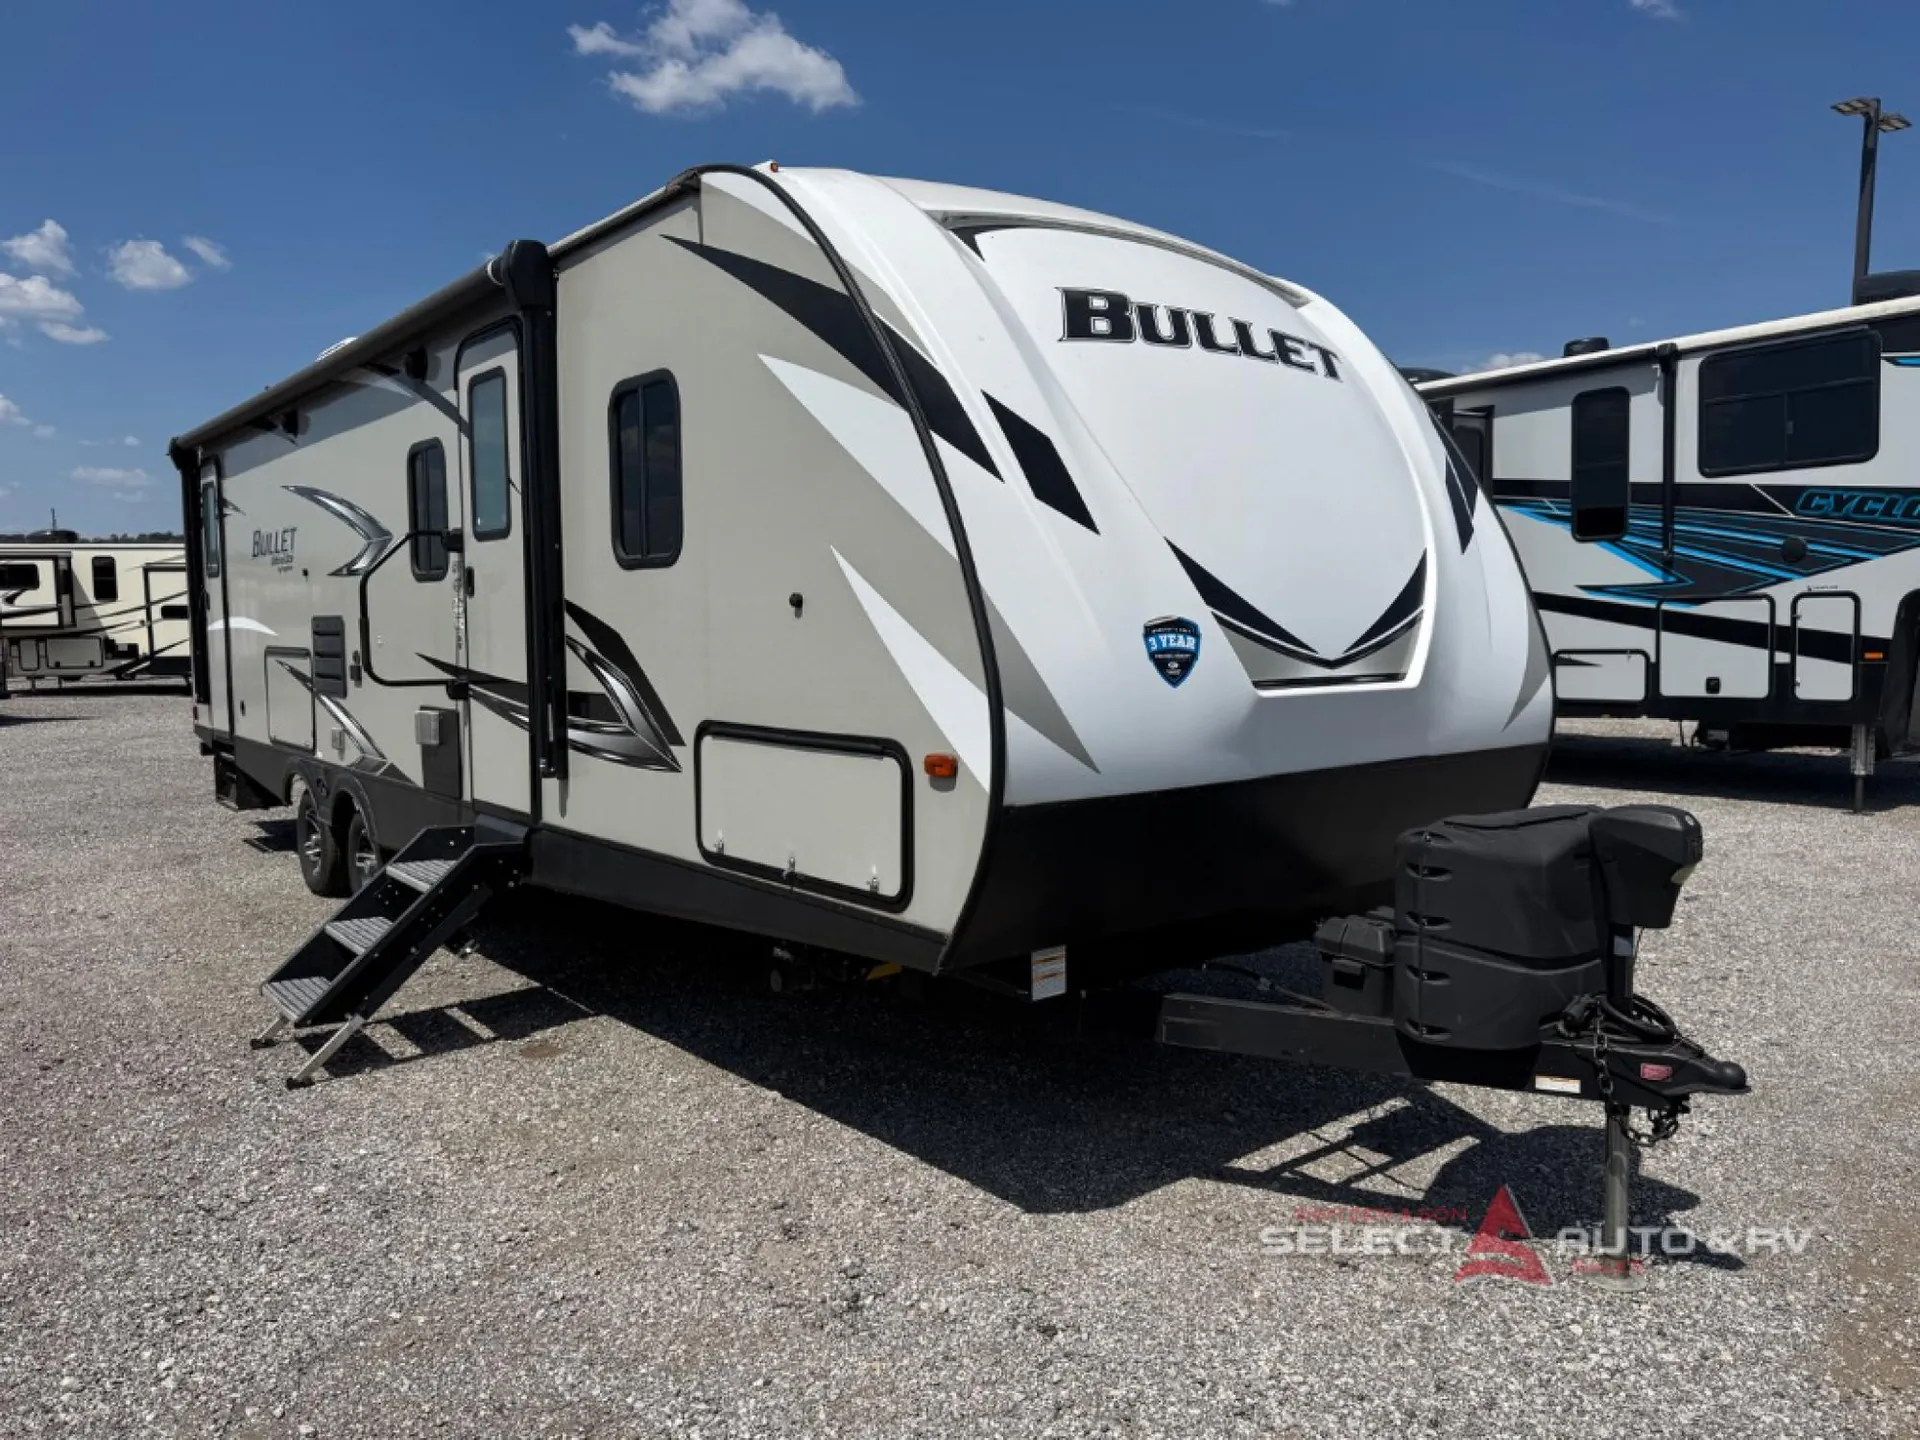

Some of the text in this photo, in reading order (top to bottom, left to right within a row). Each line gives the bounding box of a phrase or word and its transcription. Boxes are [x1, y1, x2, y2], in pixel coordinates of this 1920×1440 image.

[1054, 286, 1343, 382] BULLET
[252, 526, 298, 558] BULLET
[1148, 633, 1195, 651] 3 YEAR
